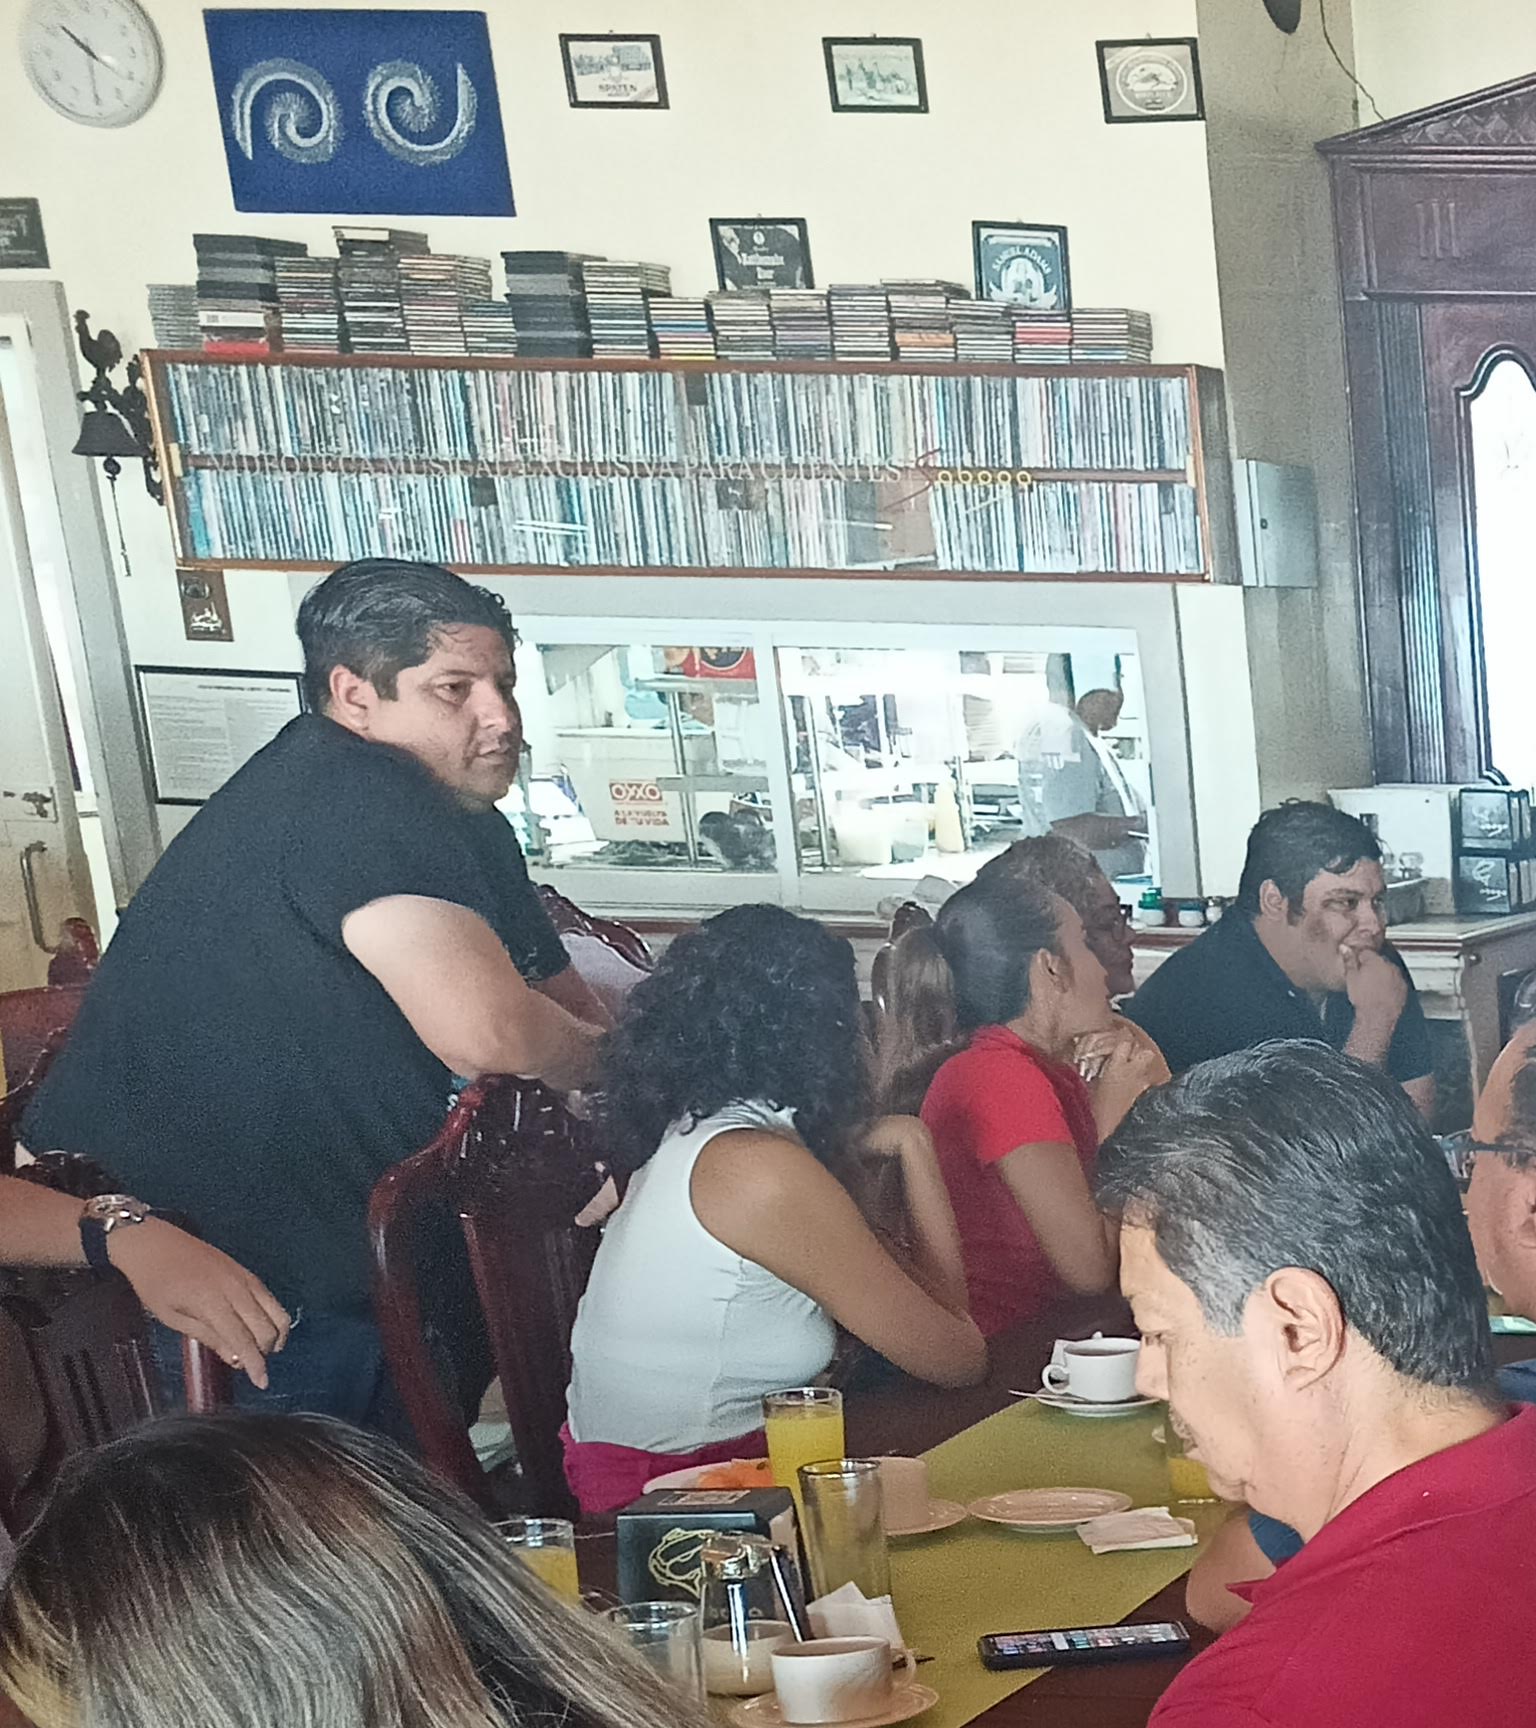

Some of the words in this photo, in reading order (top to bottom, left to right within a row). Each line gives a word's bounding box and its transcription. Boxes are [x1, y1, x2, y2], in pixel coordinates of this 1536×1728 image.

[685, 456, 755, 481] PARA
[761, 457, 901, 482] CLIENTES
[610, 784, 662, 800] OXXO
